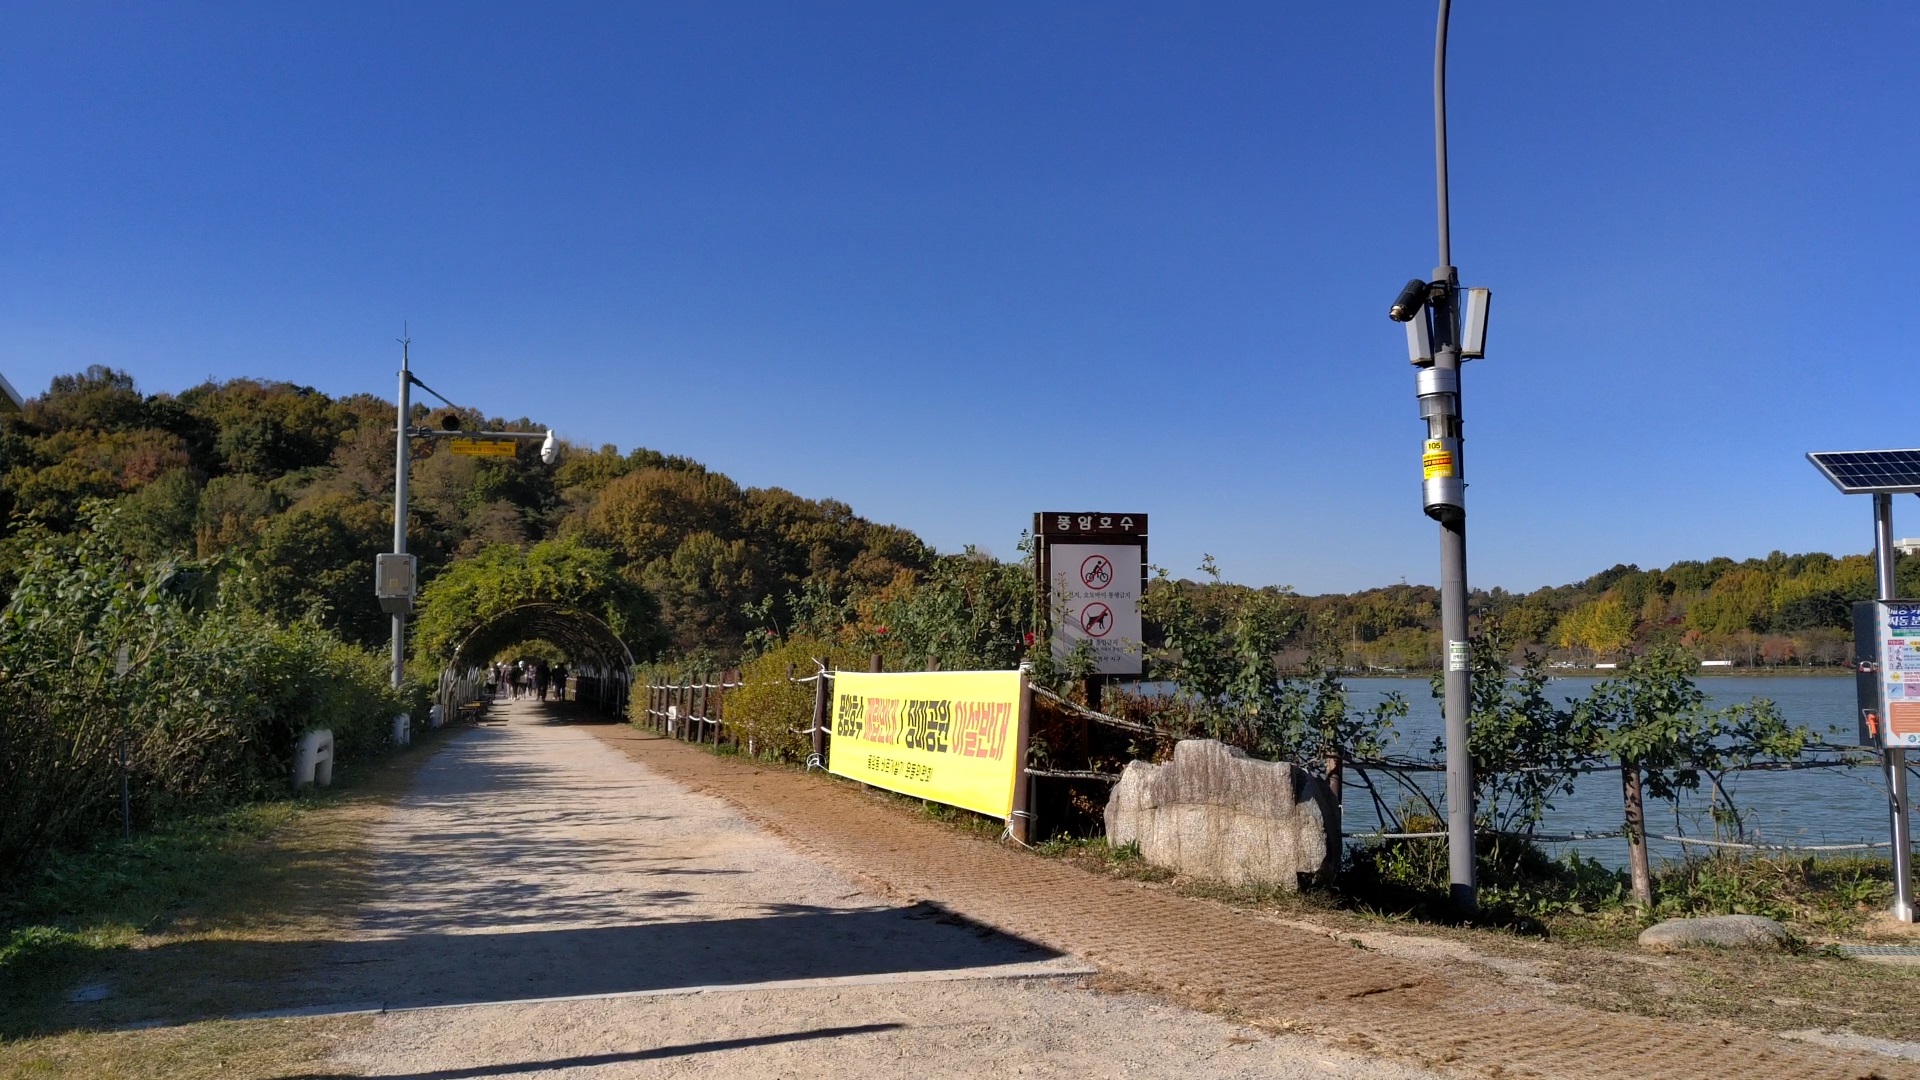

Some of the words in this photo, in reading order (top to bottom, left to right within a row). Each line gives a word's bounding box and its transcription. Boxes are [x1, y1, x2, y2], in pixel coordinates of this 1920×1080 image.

[1057, 515, 1134, 531] 풍암호수
[1083, 591, 1107, 599] 오토바이
[1108, 591, 1131, 599] 통행금지
[1888, 616, 1909, 626] 자동
[838, 694, 864, 740] 풍암호수
[863, 697, 899, 745] 매립반대
[905, 700, 951, 752] 장미공원
[952, 701, 1012, 761] 이설반대
